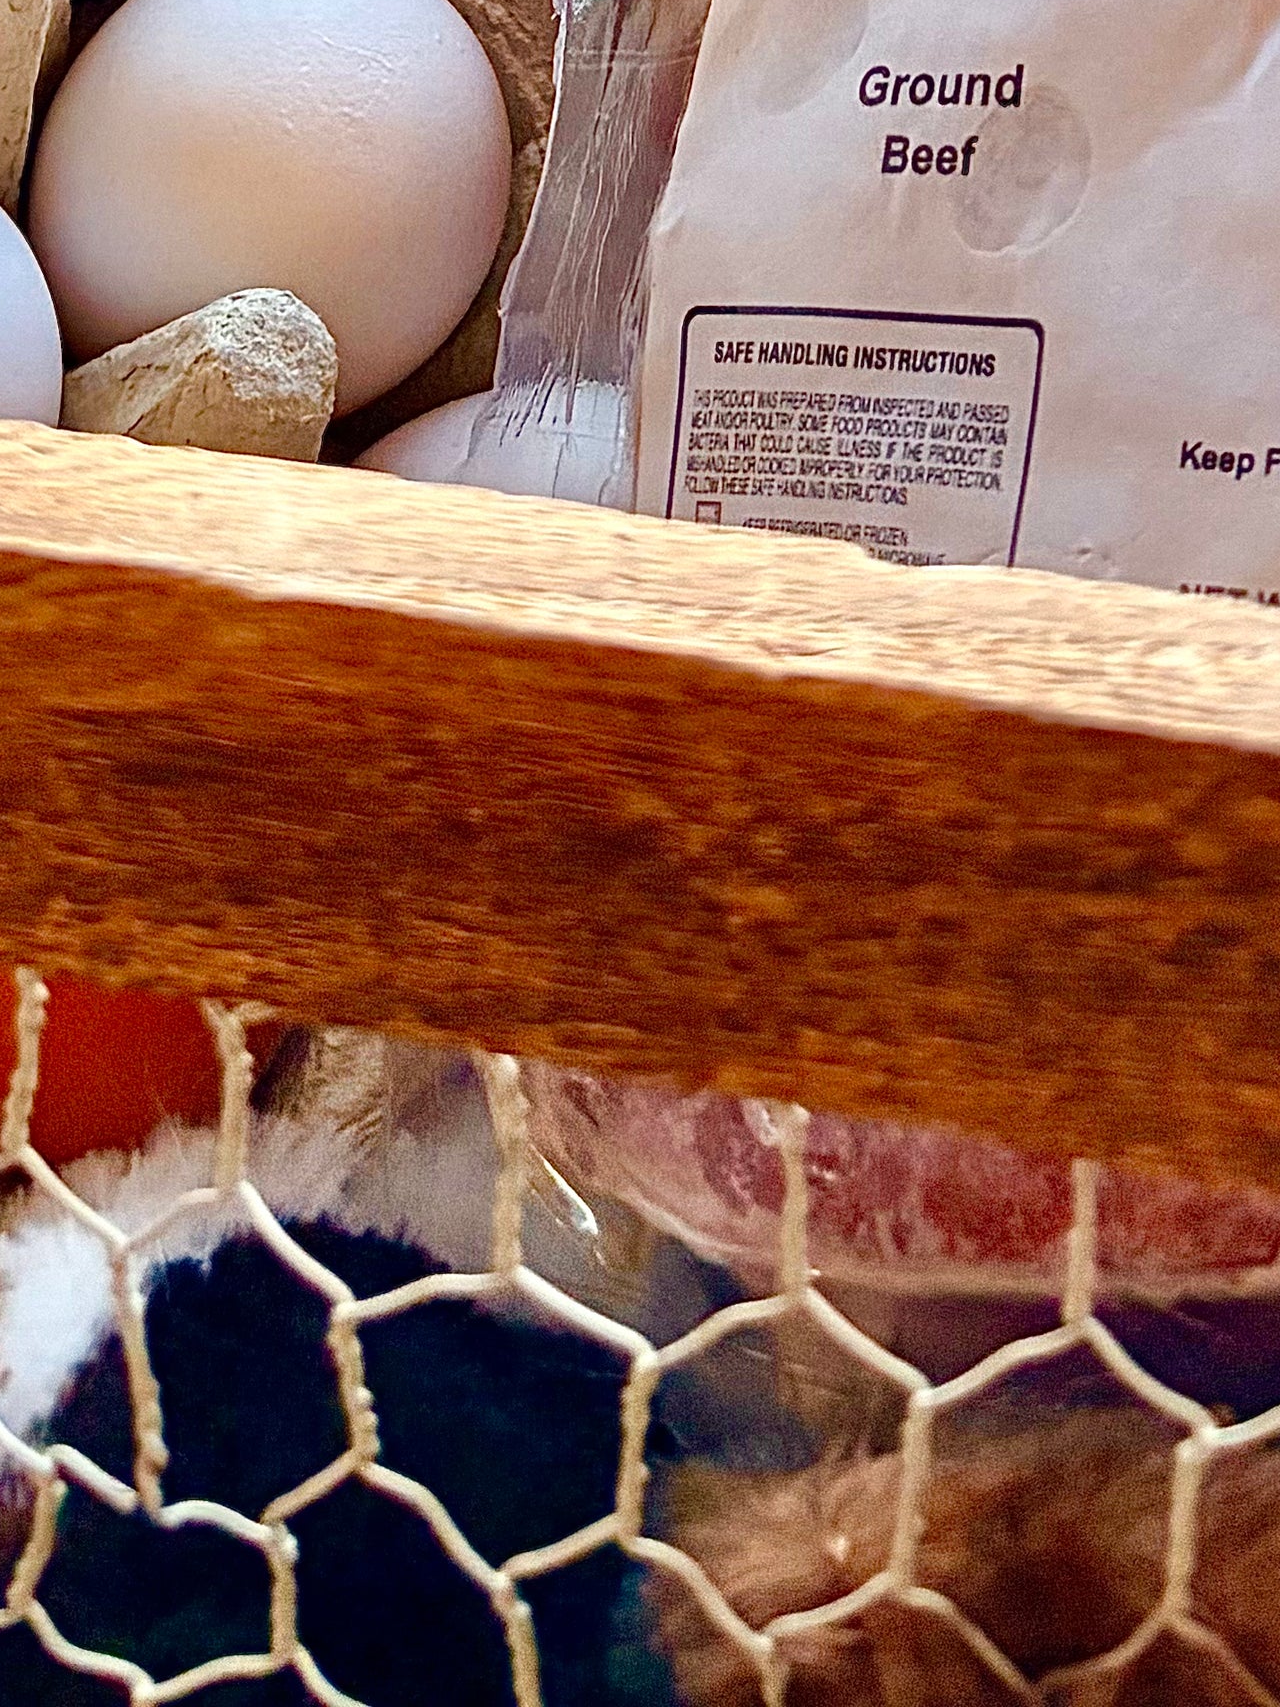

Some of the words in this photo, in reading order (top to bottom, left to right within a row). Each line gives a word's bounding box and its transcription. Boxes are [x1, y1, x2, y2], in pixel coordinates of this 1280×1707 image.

[859, 64, 1024, 107] Ground
[881, 135, 979, 175] Beef
[714, 341, 755, 364] SAFE
[758, 342, 849, 368] HANDLING
[853, 345, 996, 377] INSTRUCTIONS
[713, 389, 755, 408] PRODUCT
[757, 391, 778, 408] WAS
[780, 391, 836, 412] PREPARED
[838, 394, 870, 413] FROM
[873, 398, 934, 418] INSPECTED
[935, 402, 960, 420] AND
[964, 403, 1009, 424] PASSED
[691, 410, 712, 429] MEAT
[798, 414, 828, 432] SOME
[831, 416, 863, 435] FOOD
[865, 418, 927, 439] PRODUCTS
[930, 422, 954, 441] MAY
[958, 425, 1007, 446] CONTAIN
[688, 432, 729, 451] BACTERIA
[734, 433, 756, 451] THAT
[760, 434, 793, 453] COULD
[797, 436, 832, 455] CAUSE
[838, 439, 881, 458] ILLNESS
[886, 441, 897, 459] IF
[902, 442, 924, 461] THE
[927, 443, 986, 466] PRODUCT
[991, 449, 1004, 468] IS
[1180, 441, 1254, 479] Keep
[685, 475, 719, 494] FOLLOW
[721, 476, 750, 495] THESE
[751, 478, 775, 496] SAFE
[777, 479, 825, 498] HANDLING
[742, 456, 756, 474] OR
[757, 456, 796, 475] COOKED
[869, 462, 891, 481] FOR
[893, 464, 925, 483] YOUR
[864, 525, 908, 546] FROZEN
